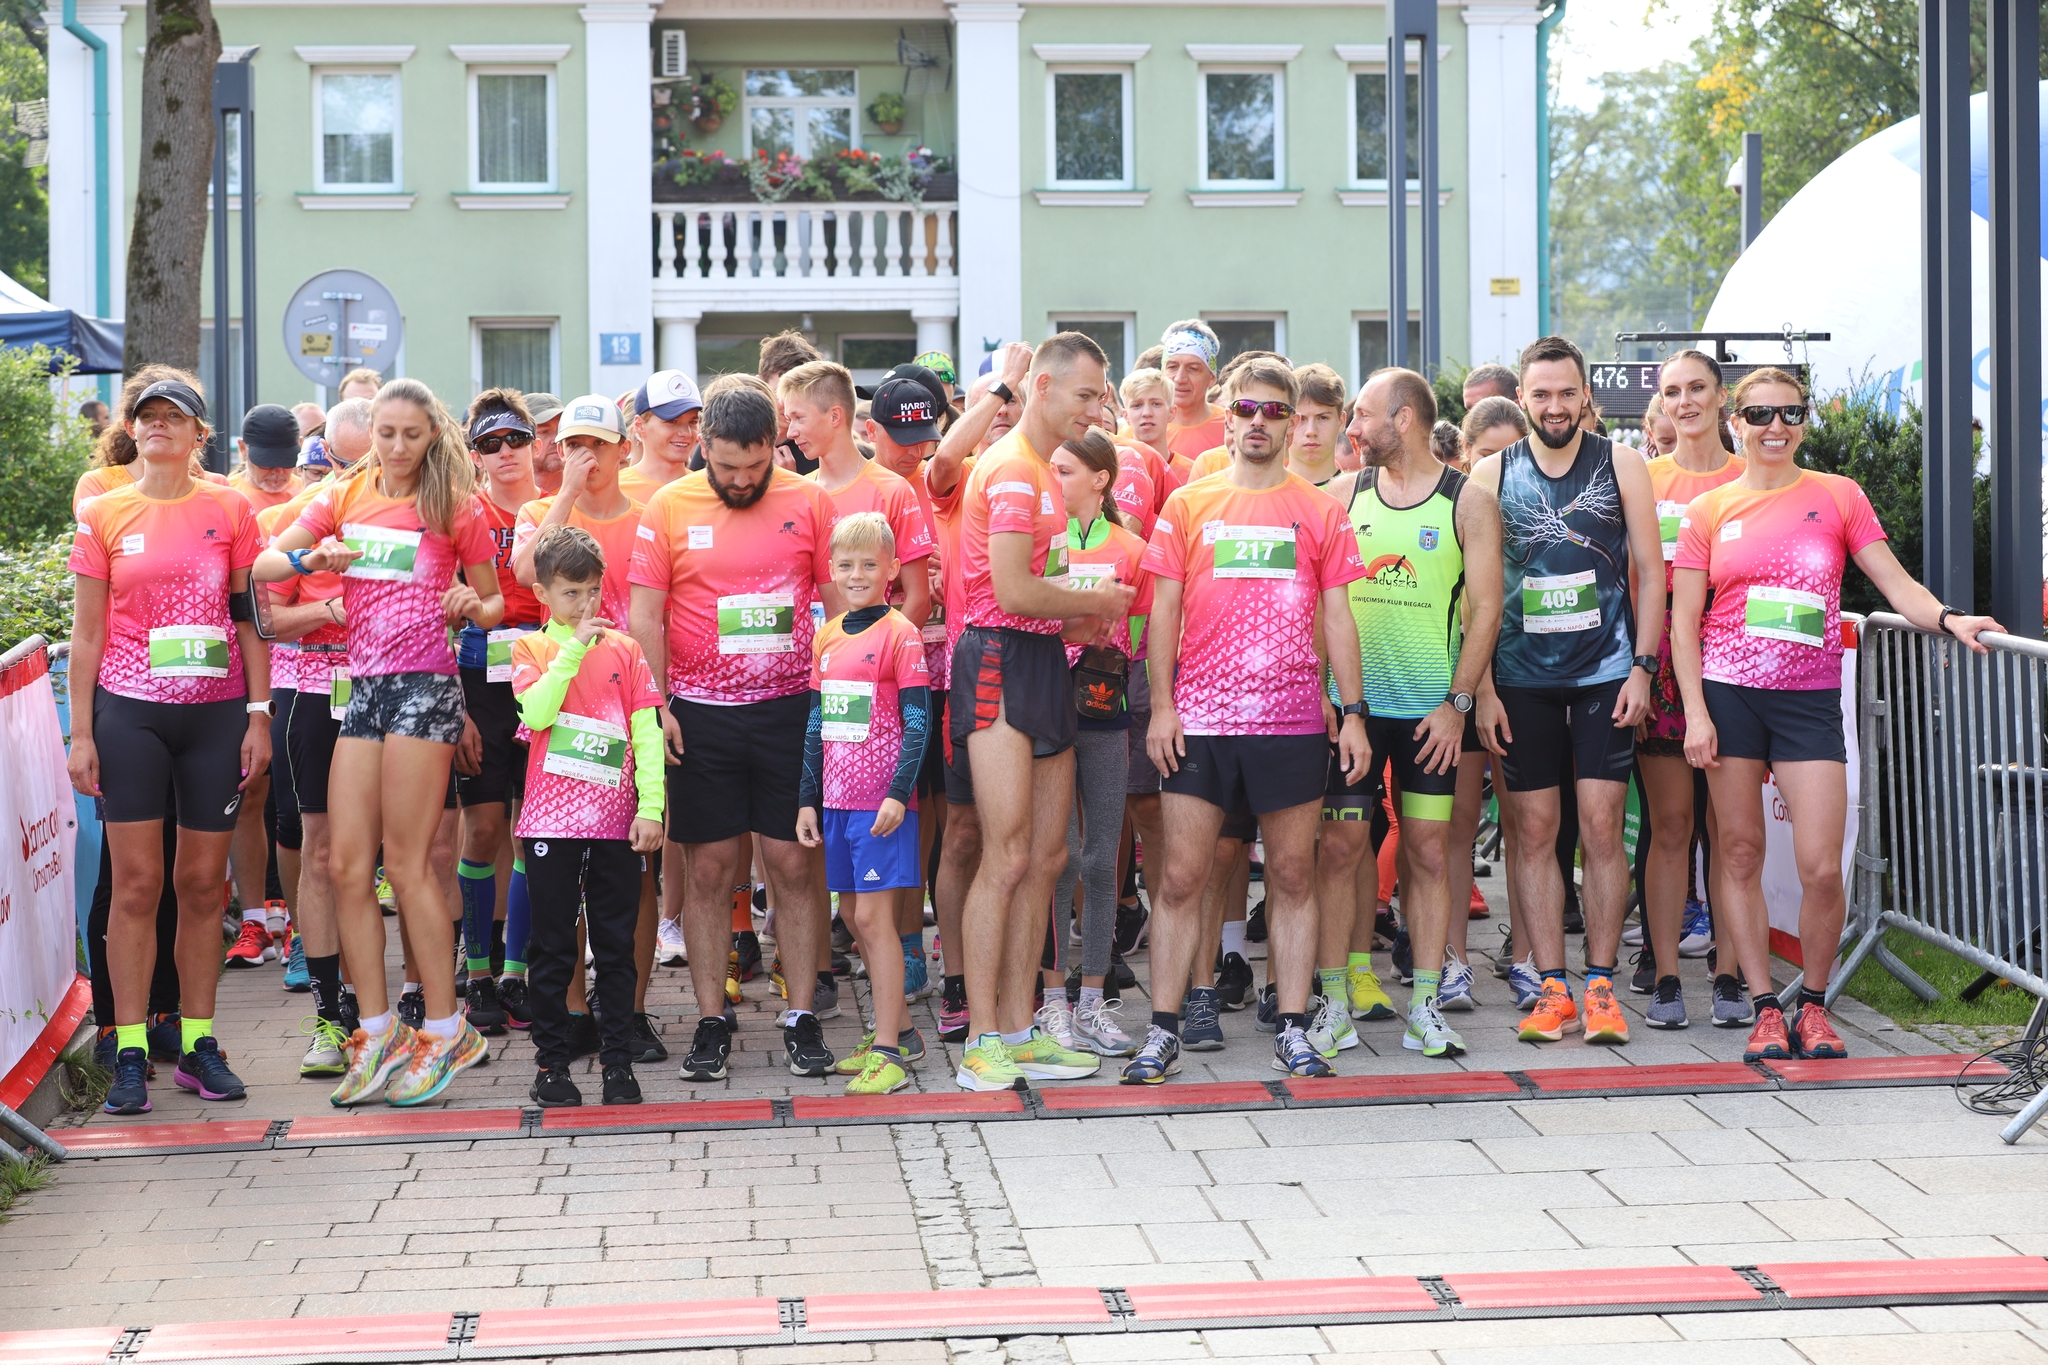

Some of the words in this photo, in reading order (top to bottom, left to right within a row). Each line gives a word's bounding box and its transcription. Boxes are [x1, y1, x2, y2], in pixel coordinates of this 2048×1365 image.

[611, 336, 631, 355] 13
[1592, 366, 1629, 389] 476
[1641, 366, 1654, 389] E
[900, 408, 934, 423] HELL
[358, 540, 396, 563] 147
[1234, 540, 1275, 561] 217
[1403, 600, 1432, 609] BIEGACZA
[1540, 588, 1579, 609] 409
[740, 608, 778, 628] 535
[1783, 604, 1795, 624] 1
[180, 639, 208, 660] 18
[824, 694, 849, 715] 533
[1085, 699, 1112, 711] adidas
[571, 731, 610, 757] 425
[607, 778, 618, 786] 425
